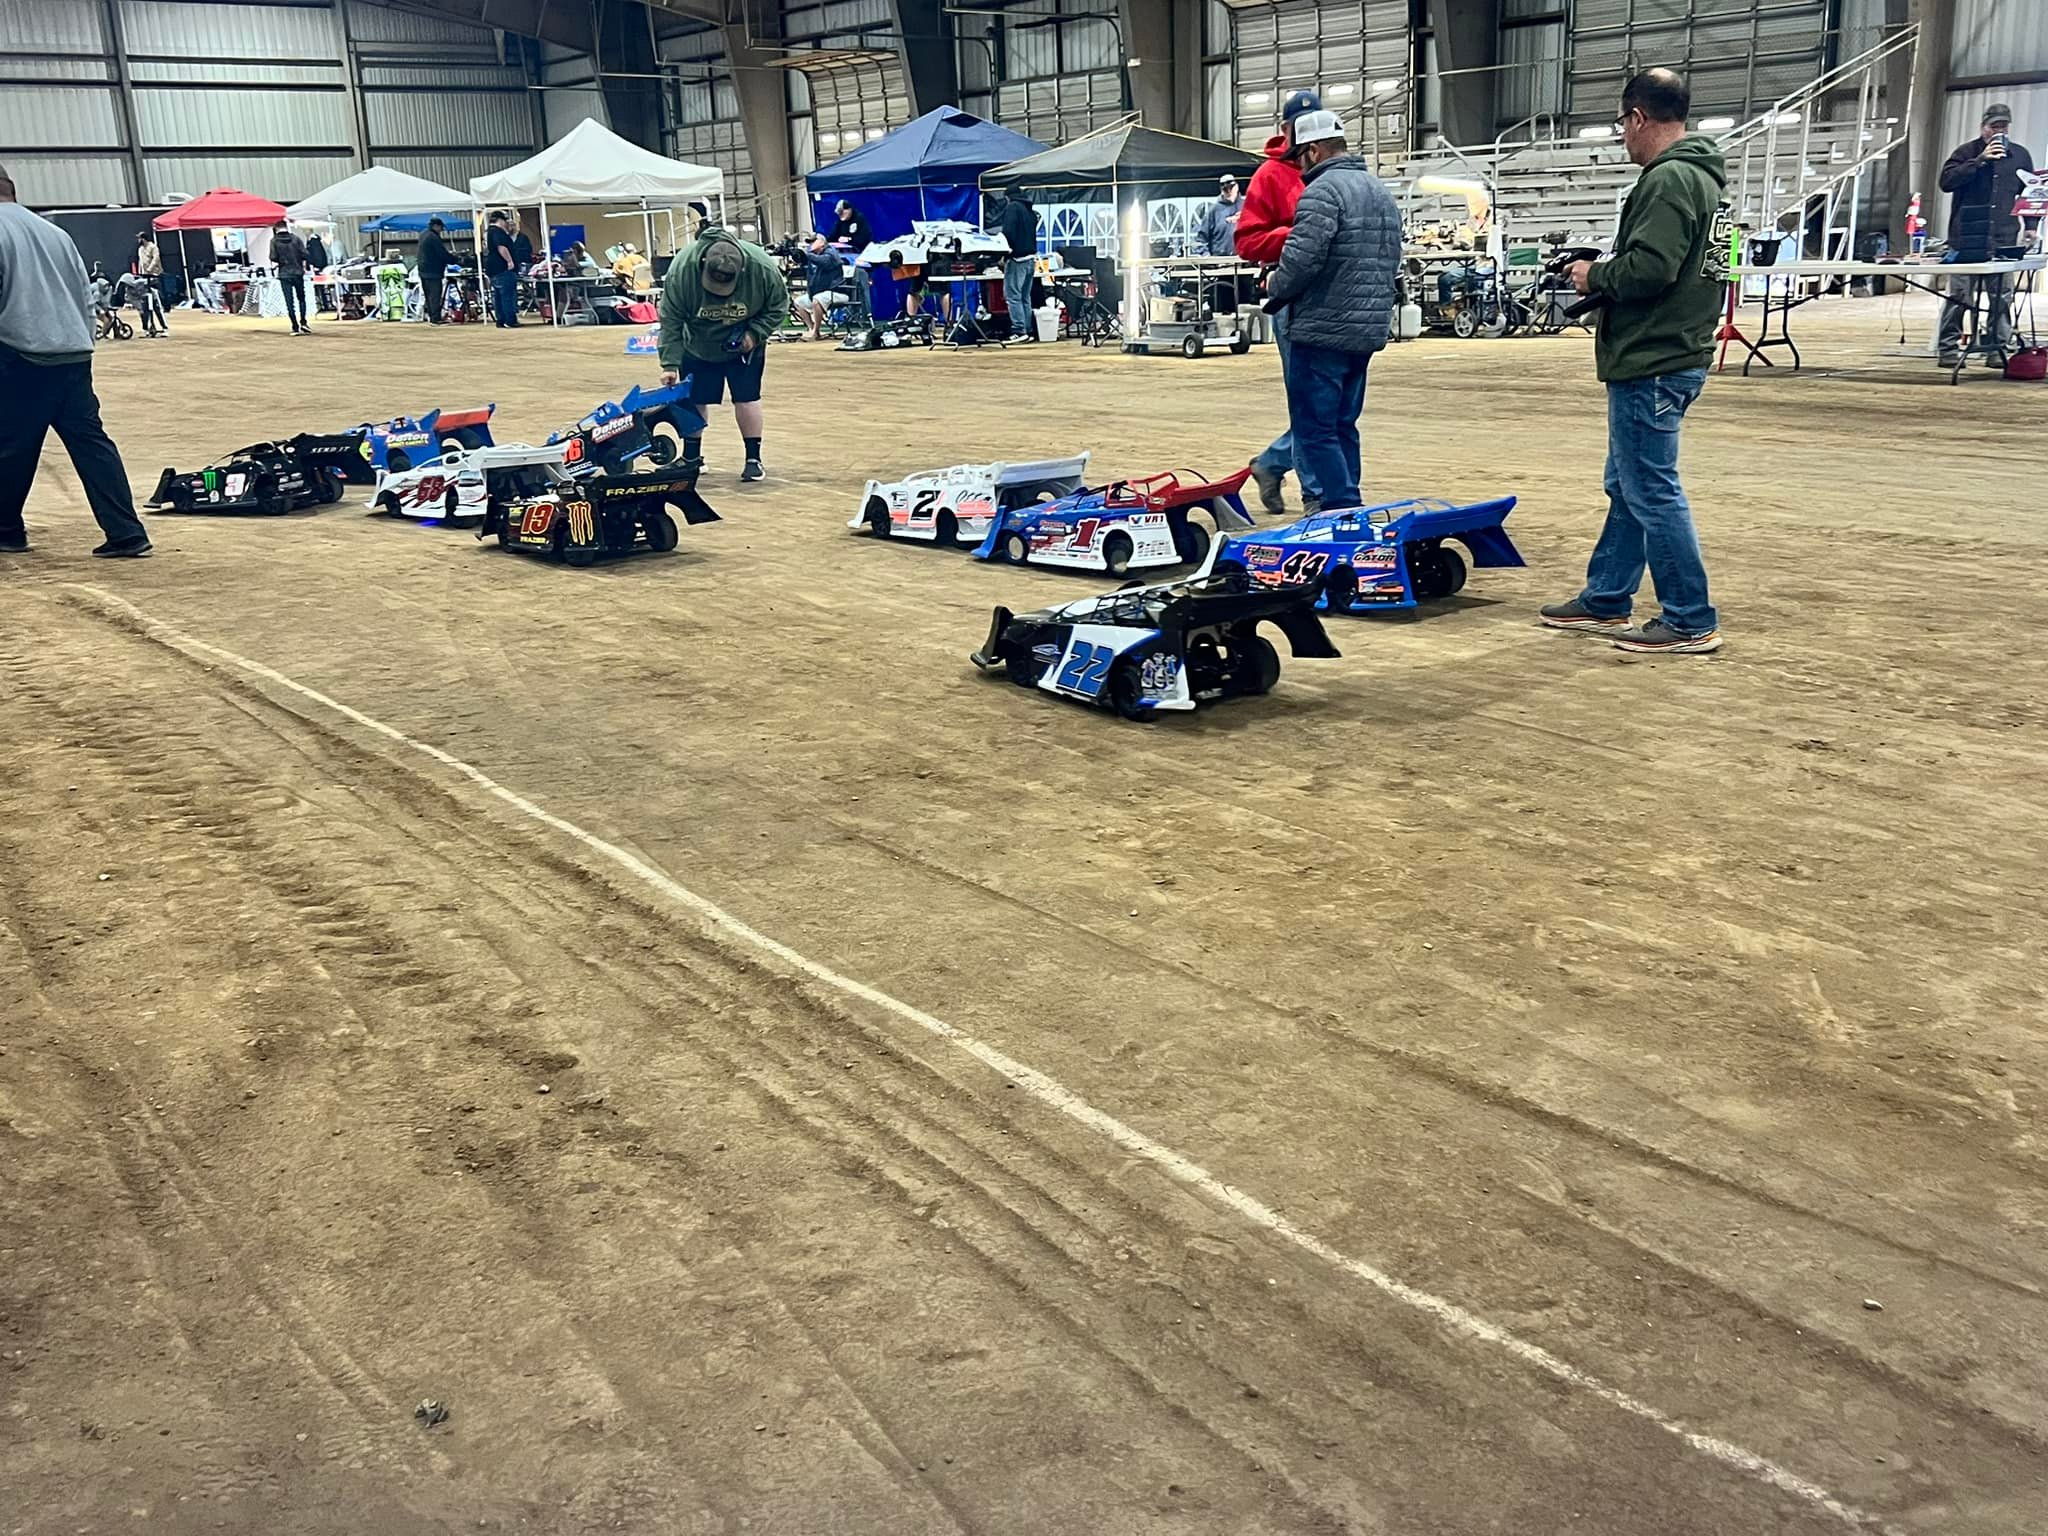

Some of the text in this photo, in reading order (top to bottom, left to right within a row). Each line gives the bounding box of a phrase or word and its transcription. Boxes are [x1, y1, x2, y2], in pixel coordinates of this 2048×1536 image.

[385, 432, 429, 443] Dalton
[592, 414, 634, 439] Dalton
[606, 484, 669, 496] FRAZIER
[520, 502, 554, 535] 13
[1144, 515, 1164, 523] VR1
[1066, 518, 1100, 553] 1
[1282, 550, 1330, 584] 44
[1352, 552, 1396, 561] GATOR
[1056, 640, 1114, 697] 22
